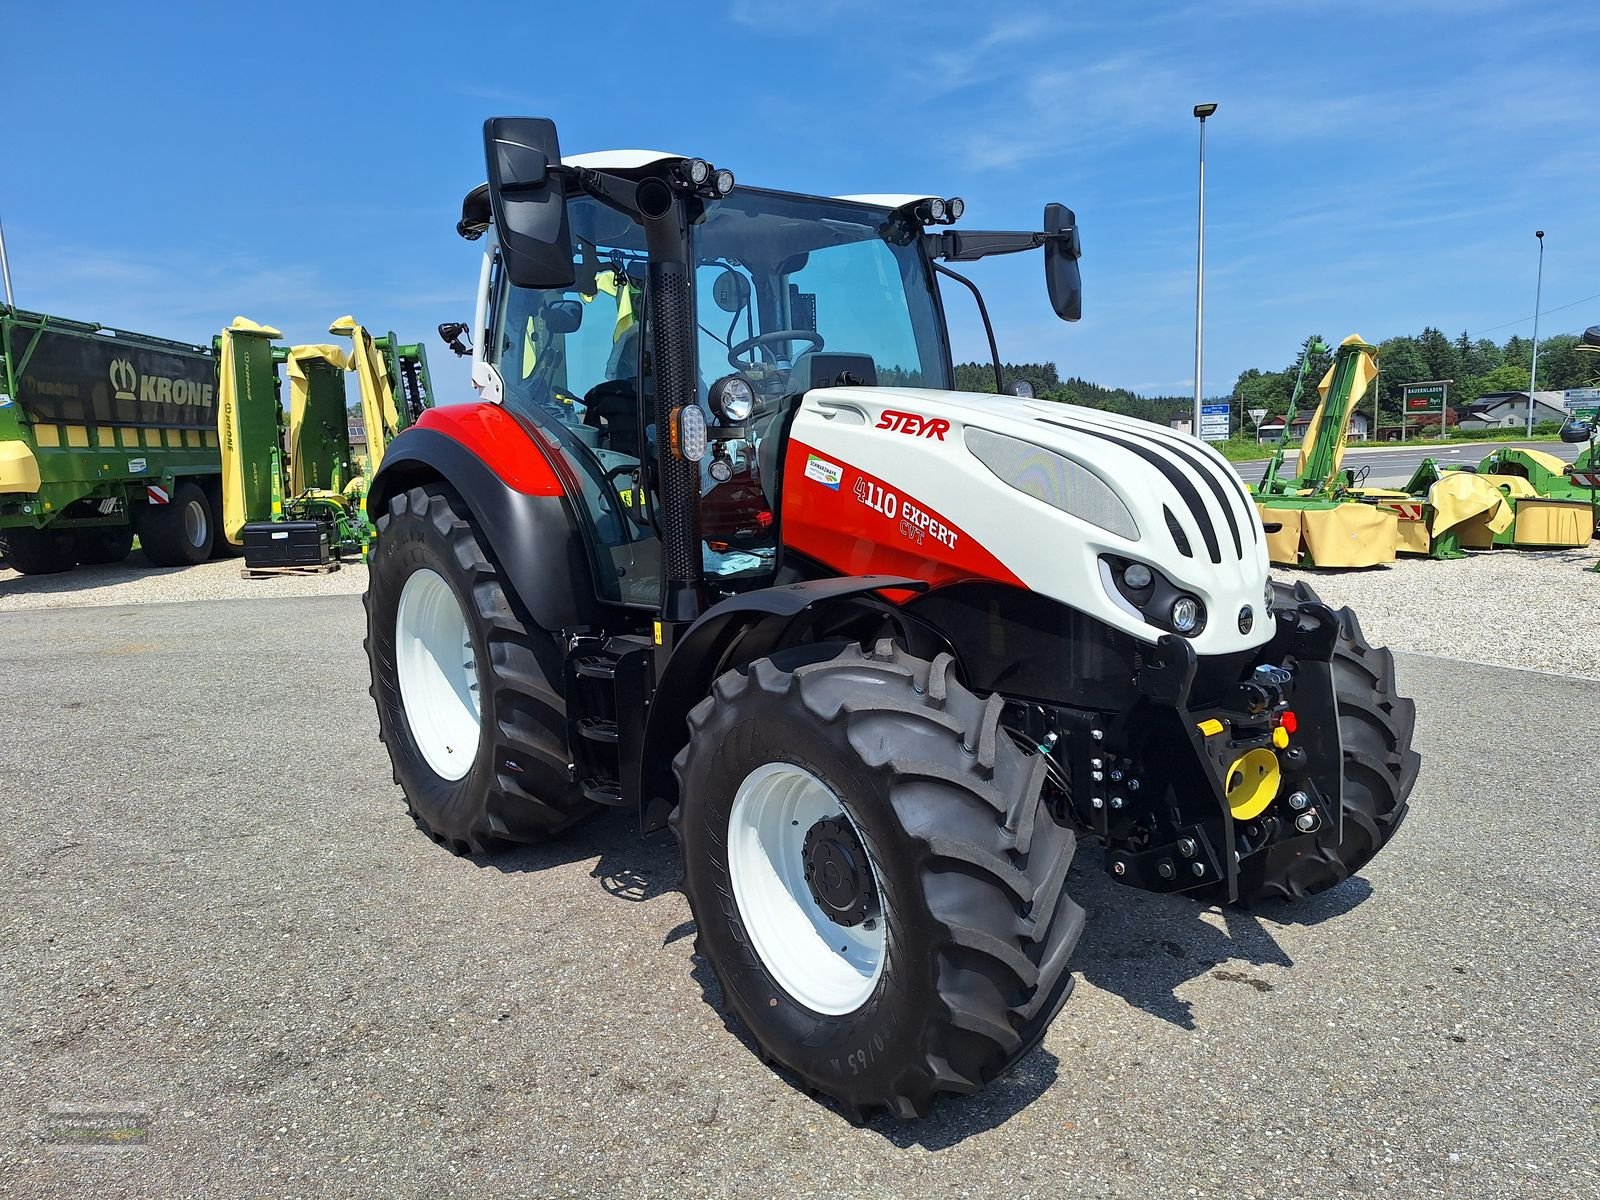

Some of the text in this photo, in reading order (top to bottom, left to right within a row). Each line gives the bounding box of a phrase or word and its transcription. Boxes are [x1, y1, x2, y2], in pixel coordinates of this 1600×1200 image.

[140, 375, 212, 407] KRONE
[225, 415, 234, 452] KRONE
[875, 410, 950, 441] STEYR
[853, 476, 958, 550] 4110 EXPERT
[900, 519, 925, 546] CVT
